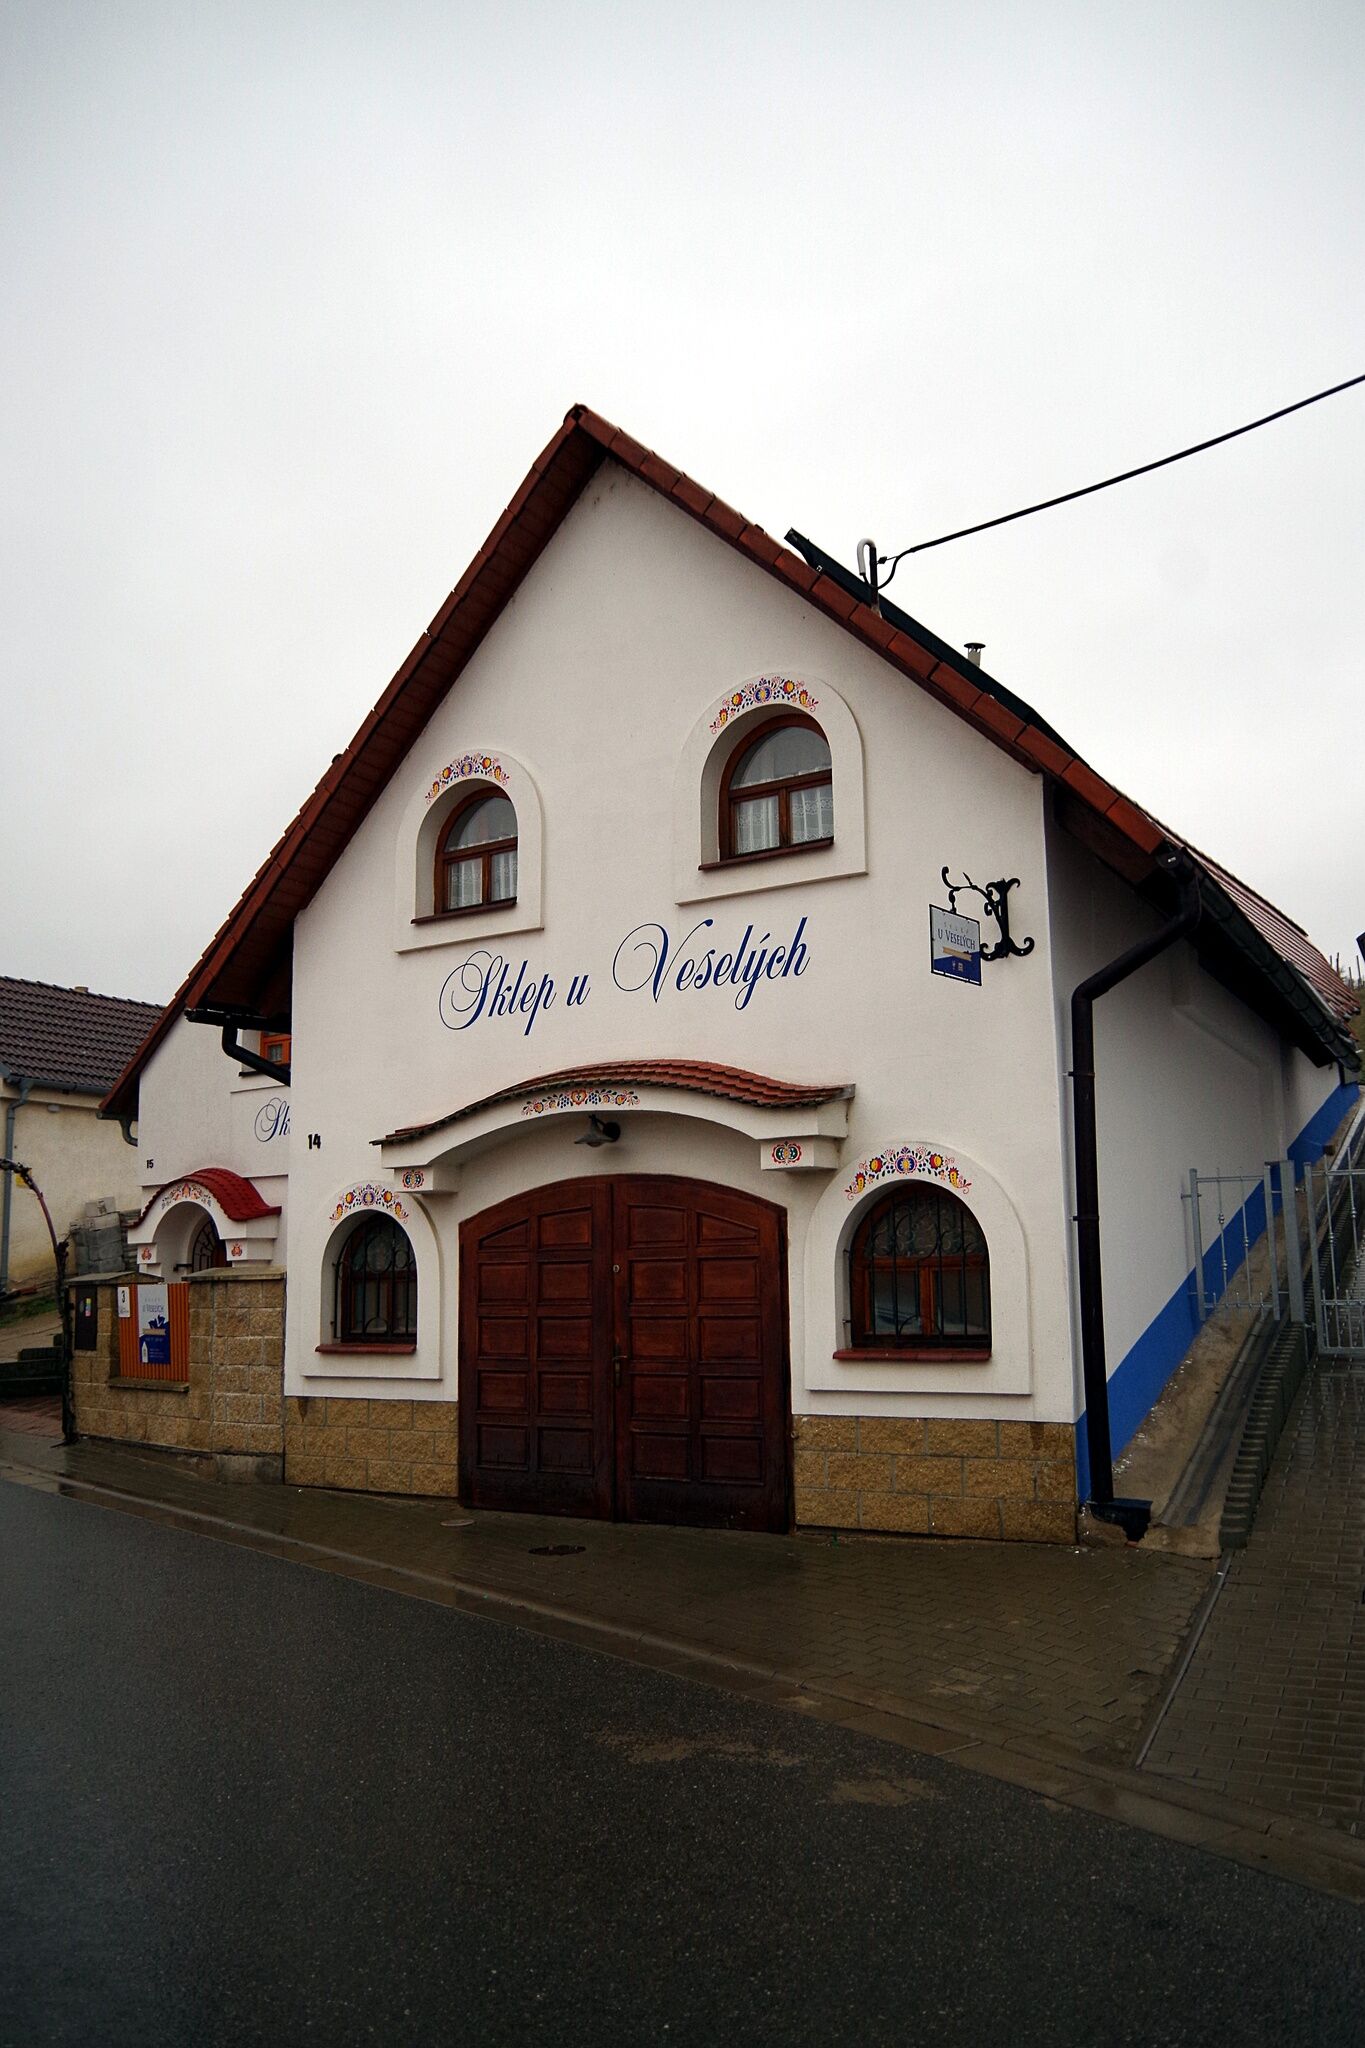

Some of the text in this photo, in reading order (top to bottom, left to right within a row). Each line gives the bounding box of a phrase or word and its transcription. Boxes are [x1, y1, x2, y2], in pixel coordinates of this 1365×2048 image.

[937, 928, 976, 951] U VESELÝCH
[439, 916, 811, 1035] Sklep u Veselých
[254, 1097, 290, 1142] Sk
[308, 1133, 321, 1150] 14
[146, 1158, 154, 1169] 15
